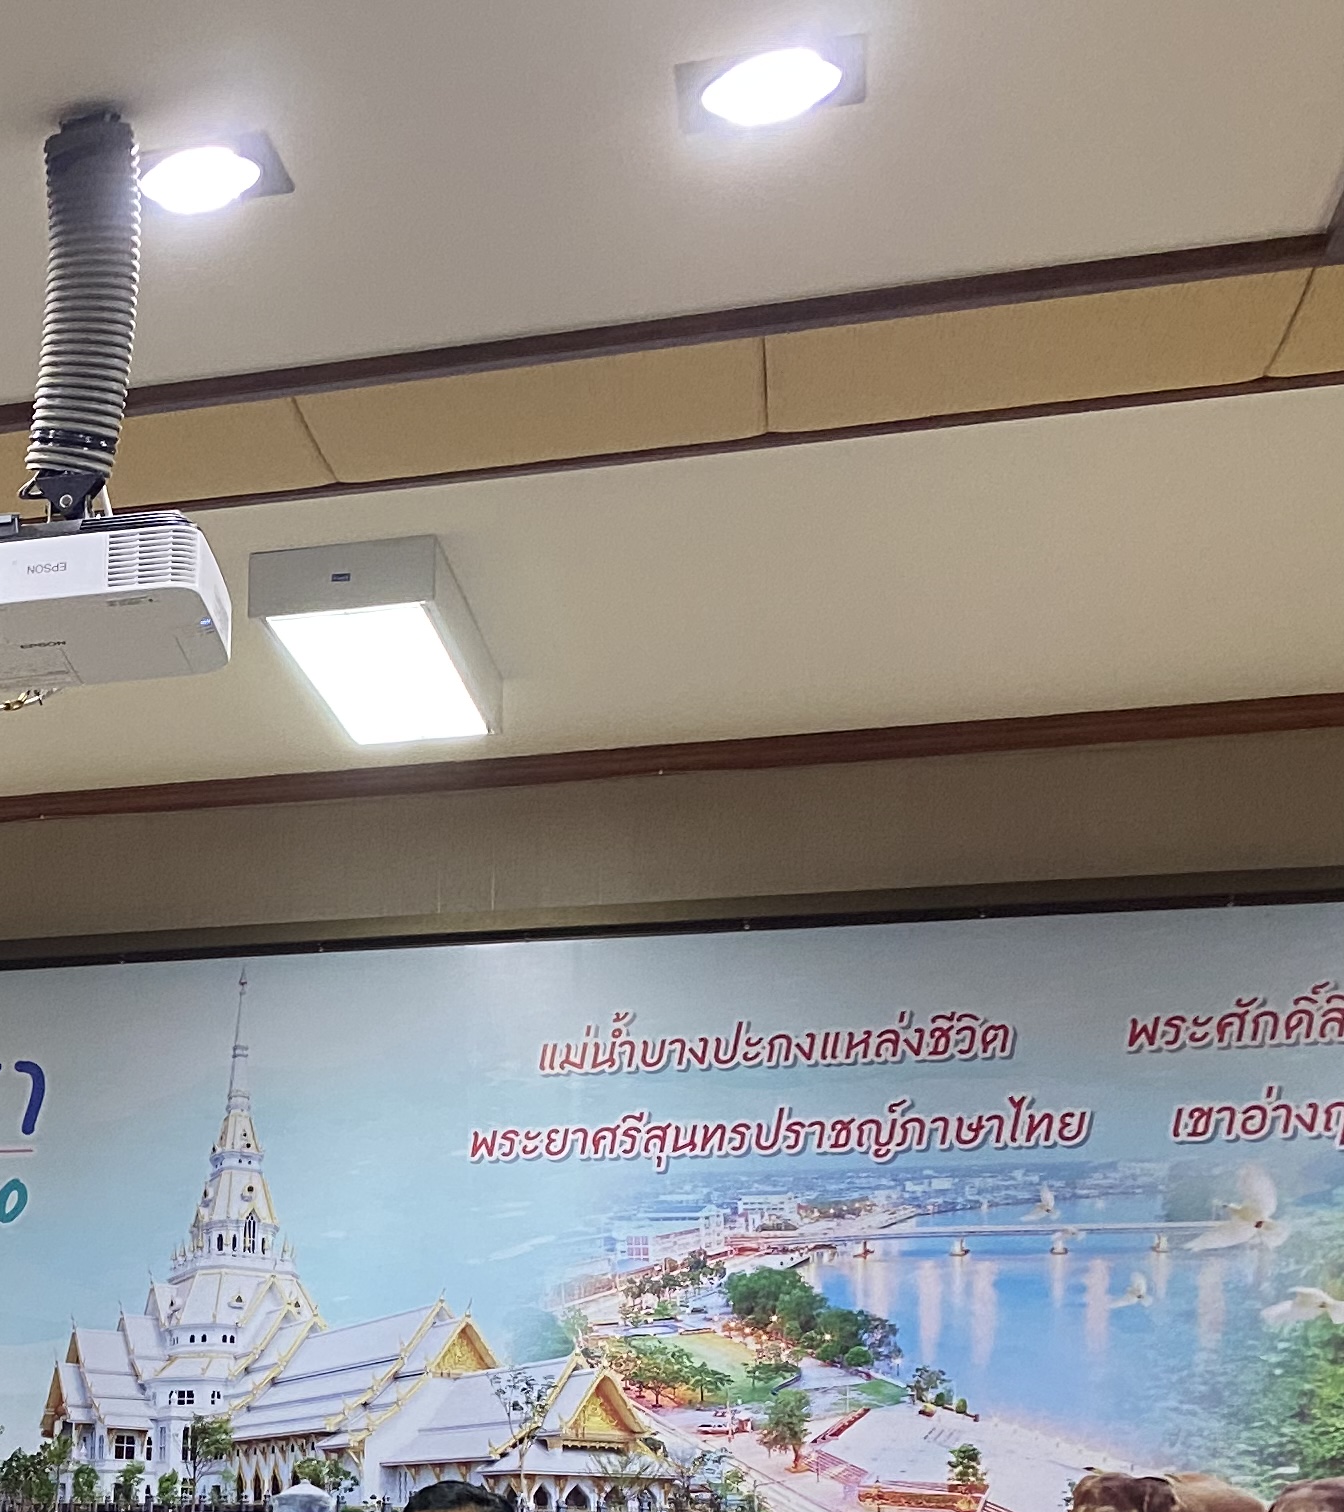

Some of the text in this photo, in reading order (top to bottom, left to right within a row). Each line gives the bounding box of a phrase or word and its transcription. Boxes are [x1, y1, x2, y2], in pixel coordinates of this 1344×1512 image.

[26, 561, 67, 575] EPSON
[539, 1012, 1010, 1072] แม่น้ำบางปะกงแหล่งชีวิต
[469, 1096, 1088, 1171] พระยาศรีสุนทรปราชญ์ภาษาไทย
